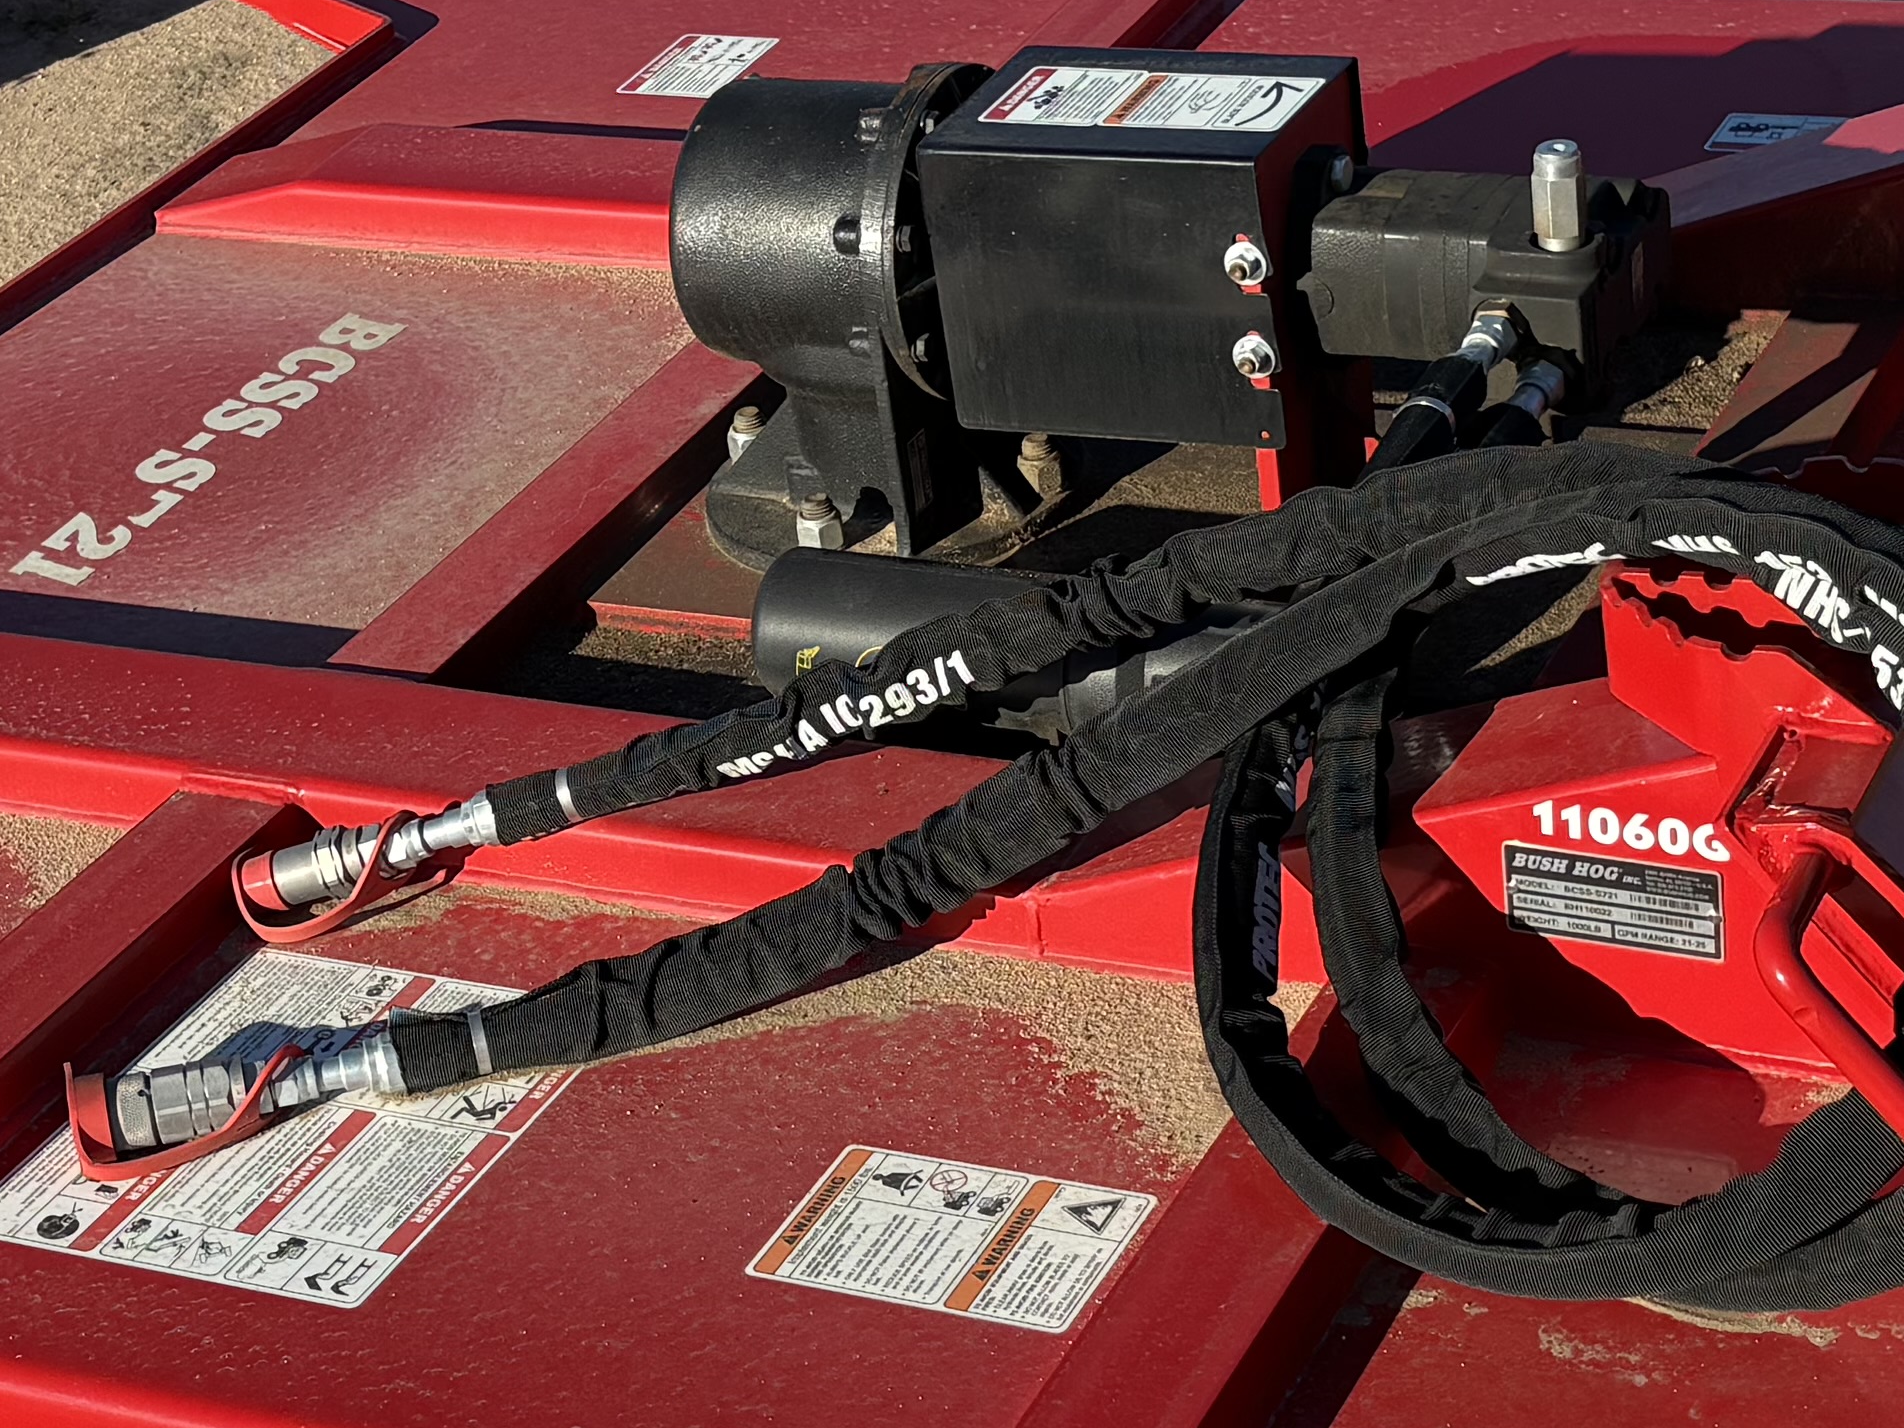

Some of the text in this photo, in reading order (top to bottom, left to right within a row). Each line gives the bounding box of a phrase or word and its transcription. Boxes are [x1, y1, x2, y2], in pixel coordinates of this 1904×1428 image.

[1532, 800, 1731, 862] 11060G
[1511, 850, 1568, 874] BUSH
[1622, 875, 1641, 885] INC.
[1516, 877, 1554, 890] MODEL:
[1516, 894, 1555, 908] SERIAL:
[1617, 928, 1638, 939] GPM
[1641, 932, 1678, 945] RANGE:
[122, 1170, 167, 1201] NGER
[268, 1156, 325, 1204] DANGER
[410, 1171, 465, 1224] DANGER
[791, 1175, 846, 1235] WARNING
[982, 1206, 1036, 1267] WARNING
